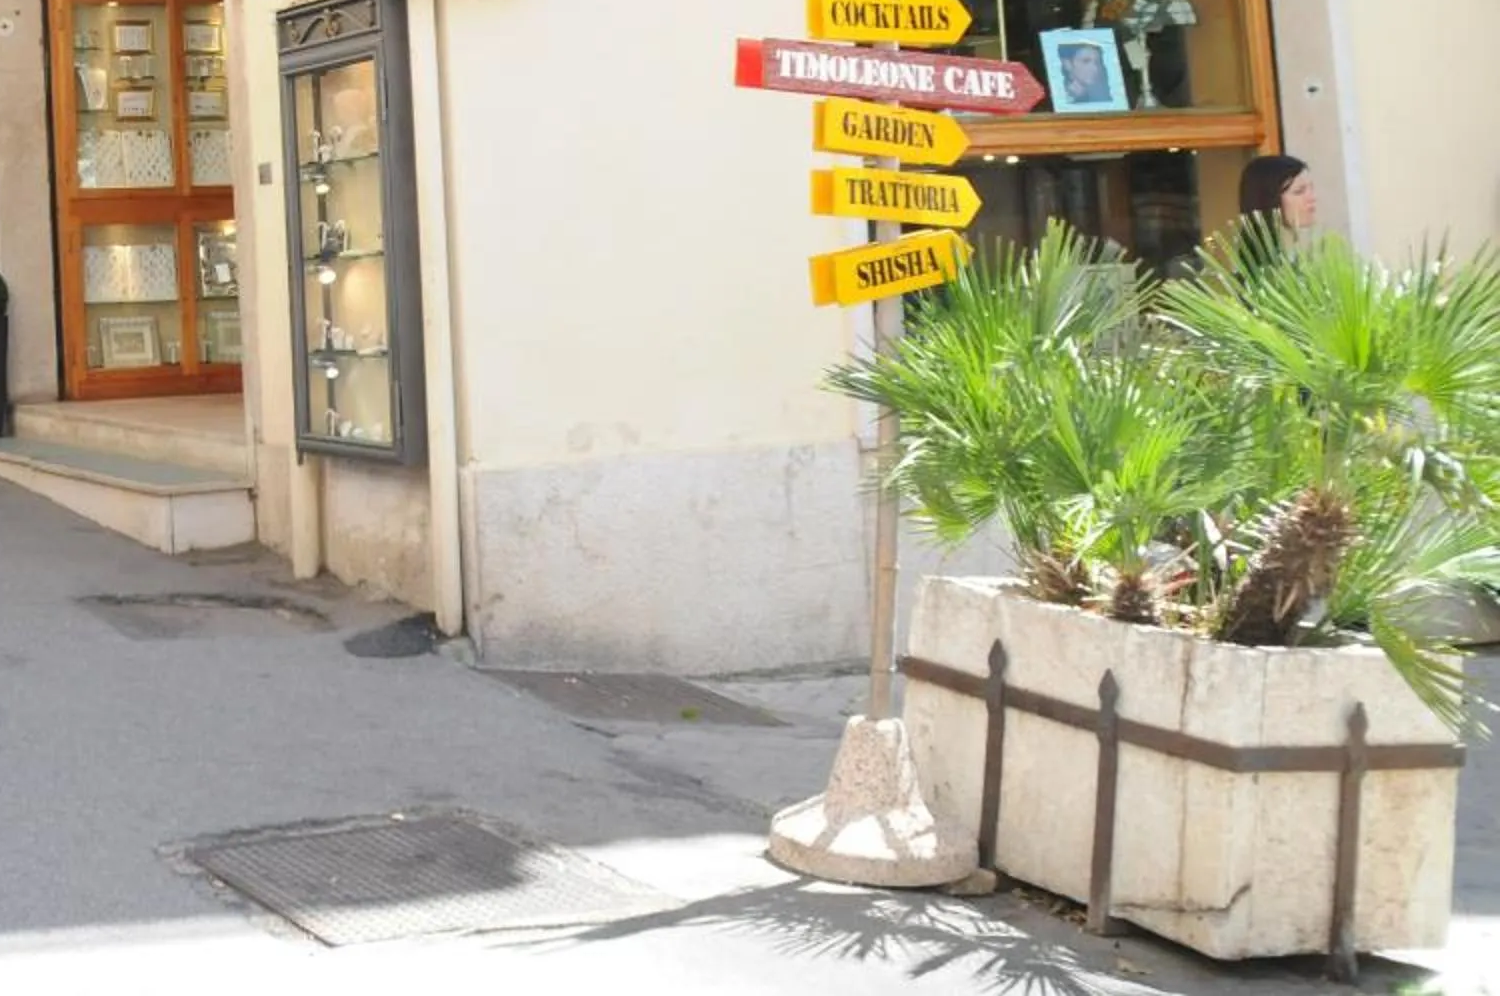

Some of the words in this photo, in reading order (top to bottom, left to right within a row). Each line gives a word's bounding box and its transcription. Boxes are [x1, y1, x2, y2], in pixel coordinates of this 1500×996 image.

[831, 0, 951, 31] COCKTAILS
[776, 48, 936, 93] TIMOLEONE
[942, 66, 1016, 100] CAFE
[843, 110, 935, 149] GARDEN
[846, 178, 961, 213] TRATTORIA
[856, 247, 941, 290] SHISHA
